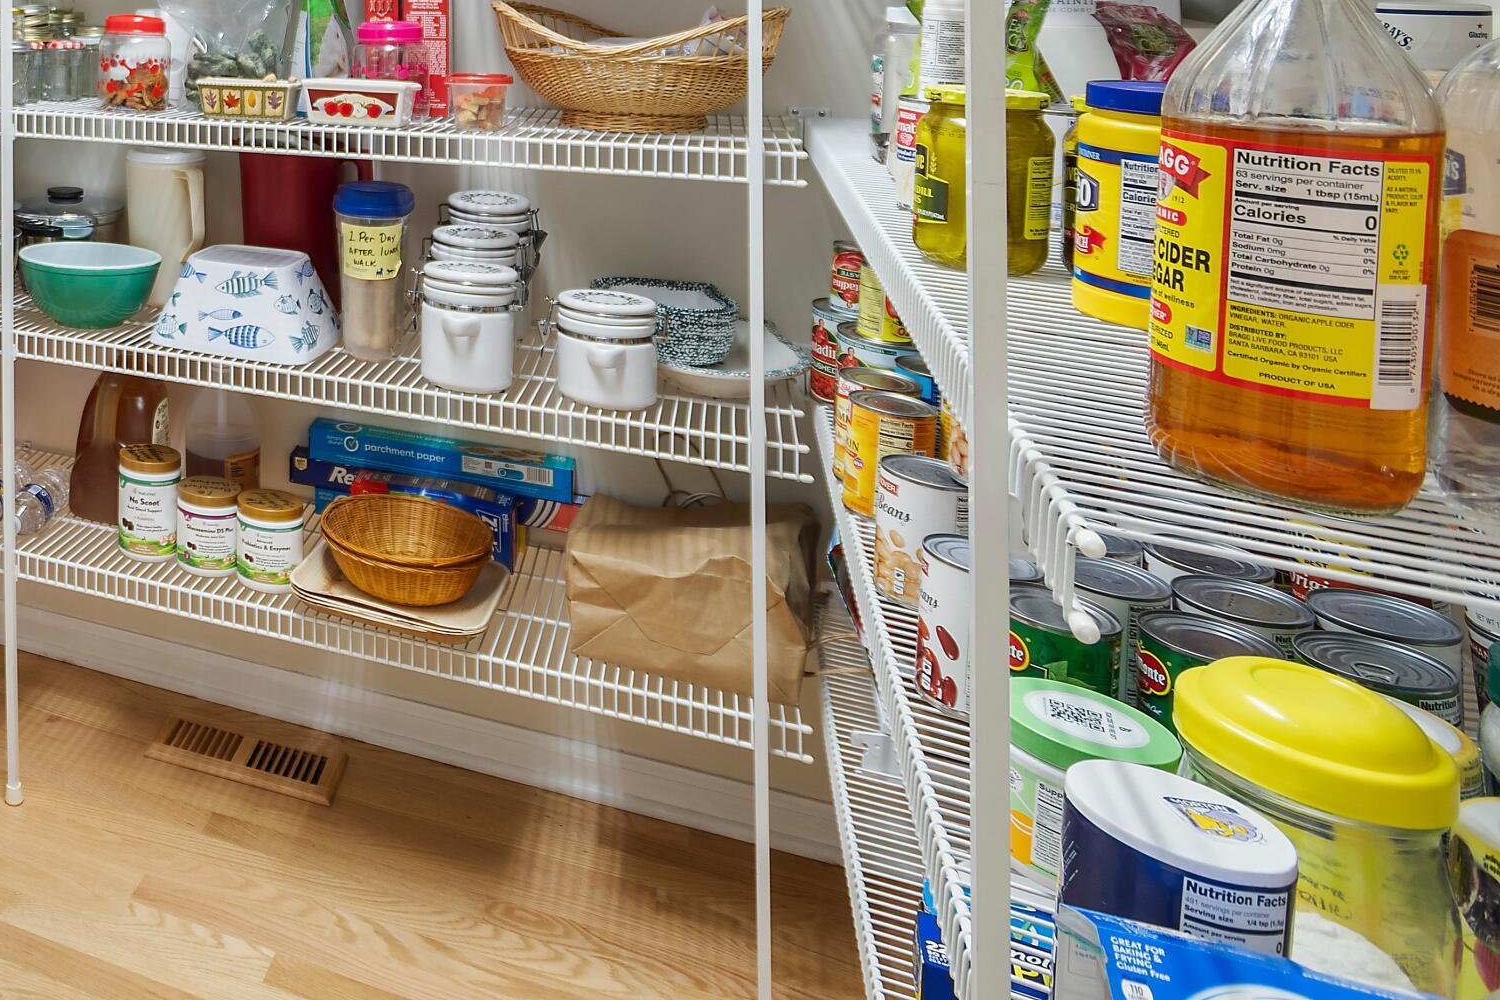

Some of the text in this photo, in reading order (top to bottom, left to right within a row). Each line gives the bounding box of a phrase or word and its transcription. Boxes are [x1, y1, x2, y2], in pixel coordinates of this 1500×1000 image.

[1160, 144, 1189, 175] AGG
[1236, 151, 1380, 177] Nutrition Facts
[1236, 170, 1364, 190] 63 servings per container
[1236, 180, 1379, 202] Serv. size 1 tbsp (15mL)
[1234, 204, 1376, 230] Calories 0
[1234, 231, 1253, 240] Total
[1257, 234, 1270, 242] Fat
[1272, 237, 1283, 246] 0g
[1159, 238, 1210, 273] CIDER
[1233, 242, 1285, 256] Sodium 0mg
[354, 259, 377, 267] WALK
[1232, 252, 1252, 260] Total
[1255, 254, 1317, 270] Carbohydrate
[1232, 262, 1274, 276] Protein 0g
[1164, 292, 1195, 309] wellness
[1259, 372, 1335, 389] PRODUCT OF USA
[364, 442, 445, 464] parchment paper
[187, 524, 215, 533] Glucosamine
[1304, 560, 1328, 568] BEST
[1420, 700, 1457, 710] Nutrition
[1186, 880, 1286, 907] Nutrition Facts
[1185, 904, 1233, 923] Serving size
[1211, 929, 1245, 943] per serving
[1110, 936, 1165, 956] GREAT FOR
[1113, 945, 1162, 964] BAKING &
[1114, 953, 1152, 969] FRYING
[1116, 962, 1170, 982] Gluten Free
[1130, 984, 1143, 996] 110
